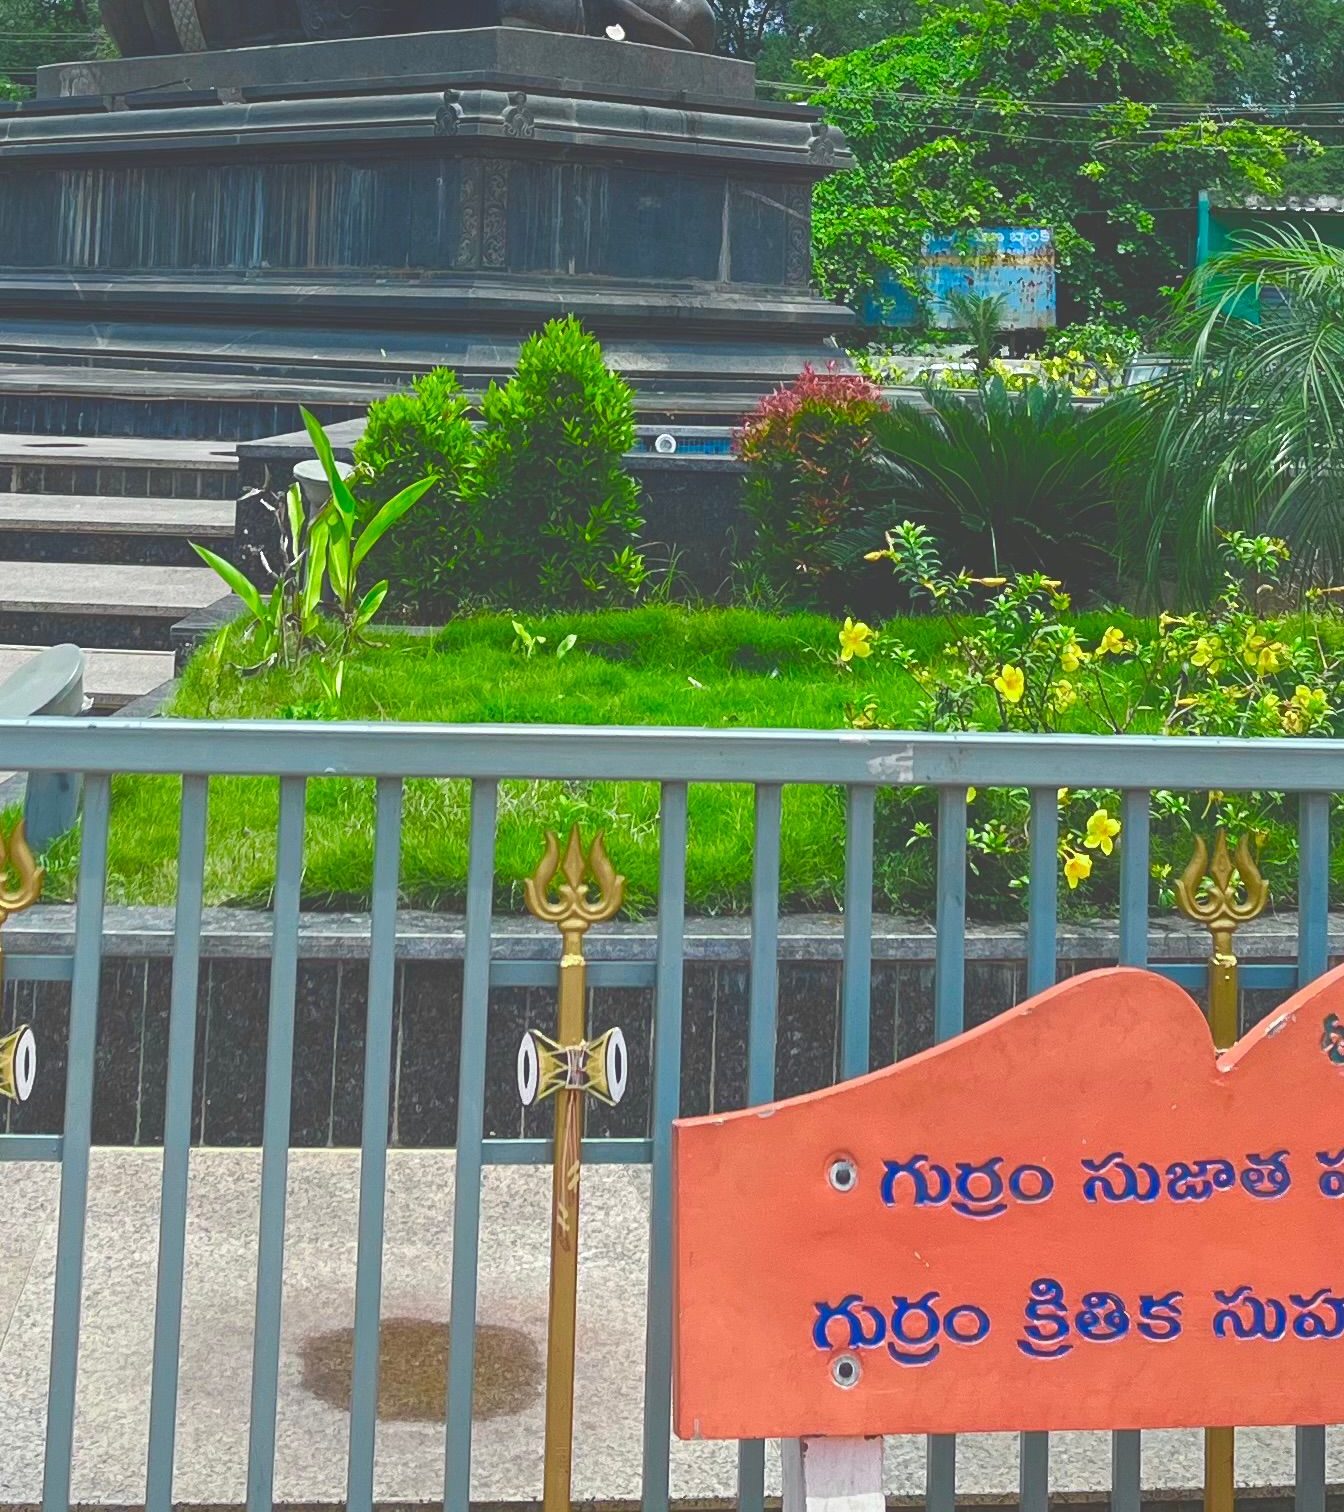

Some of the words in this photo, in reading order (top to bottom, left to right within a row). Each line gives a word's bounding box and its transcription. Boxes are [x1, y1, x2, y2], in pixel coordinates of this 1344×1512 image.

[880, 1153, 1055, 1218] గుర్రం
[1081, 1150, 1292, 1203] సుజాత
[812, 1291, 992, 1367] గుర్రం
[1017, 1277, 1184, 1359] క్రితిక
